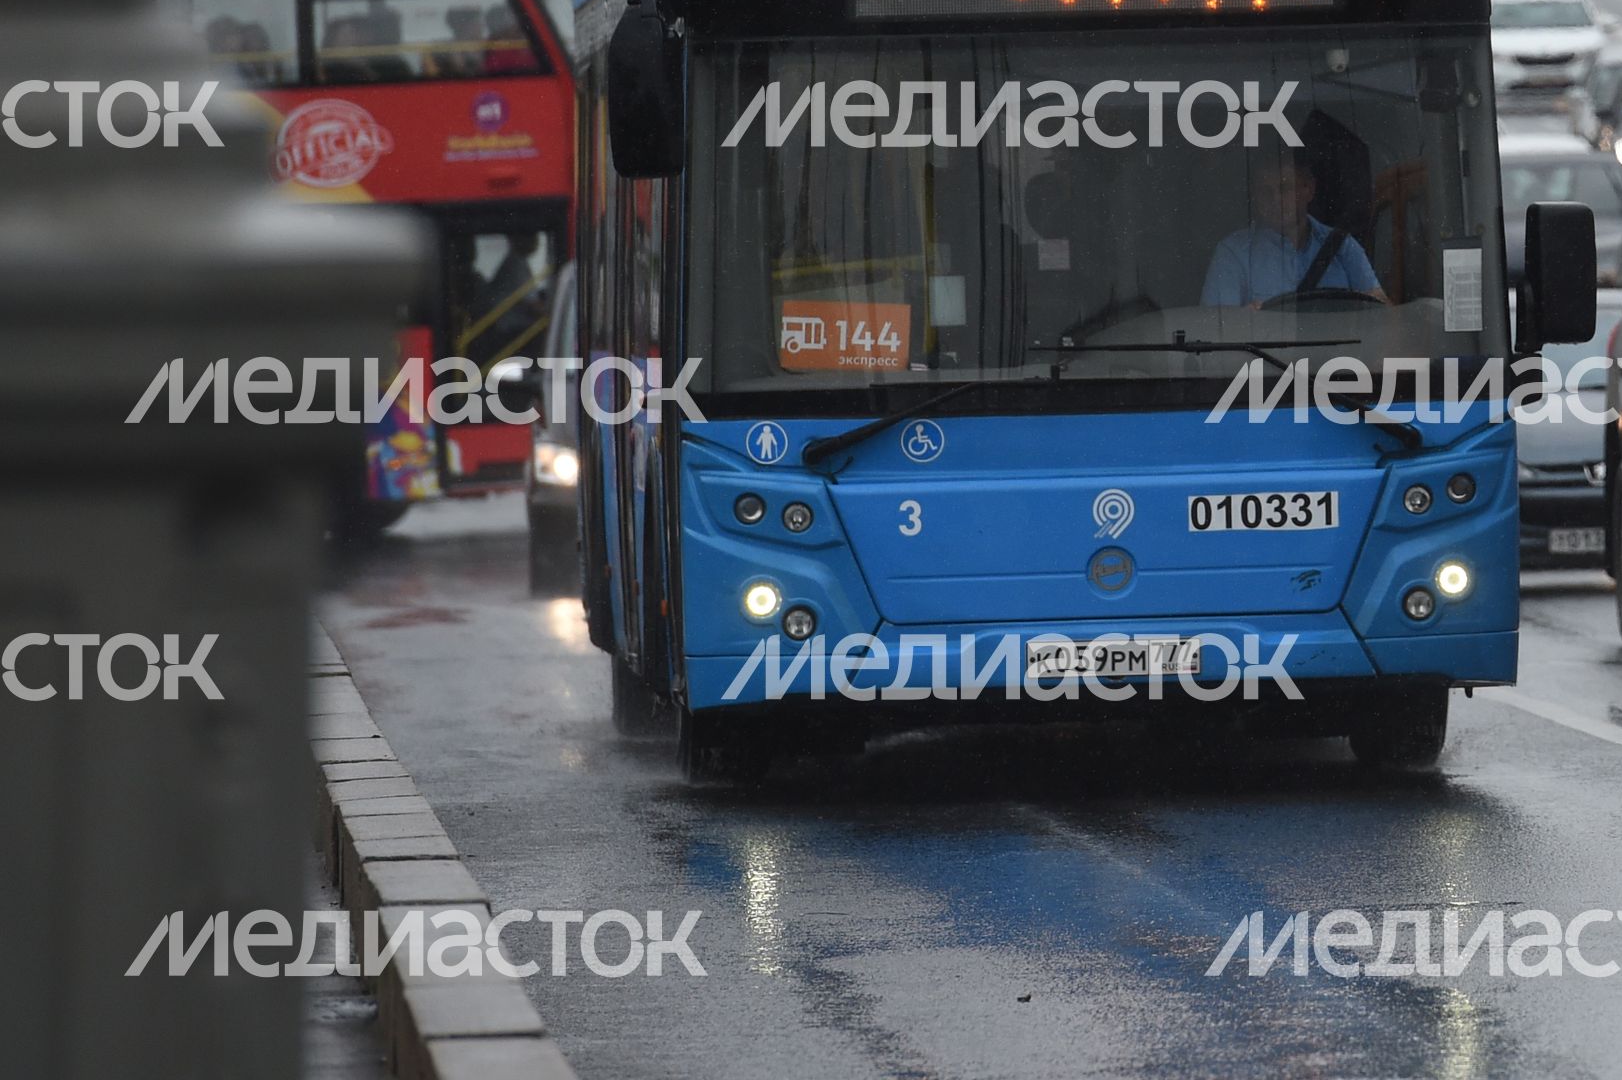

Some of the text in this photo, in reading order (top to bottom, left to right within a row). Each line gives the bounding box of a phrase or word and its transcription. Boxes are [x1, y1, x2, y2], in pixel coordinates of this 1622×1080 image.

[835, 319, 901, 353] 144
[838, 356, 899, 368] экспресс
[898, 499, 923, 537] 3
[1190, 491, 1333, 530] 010331
[1151, 641, 1193, 663] 777
